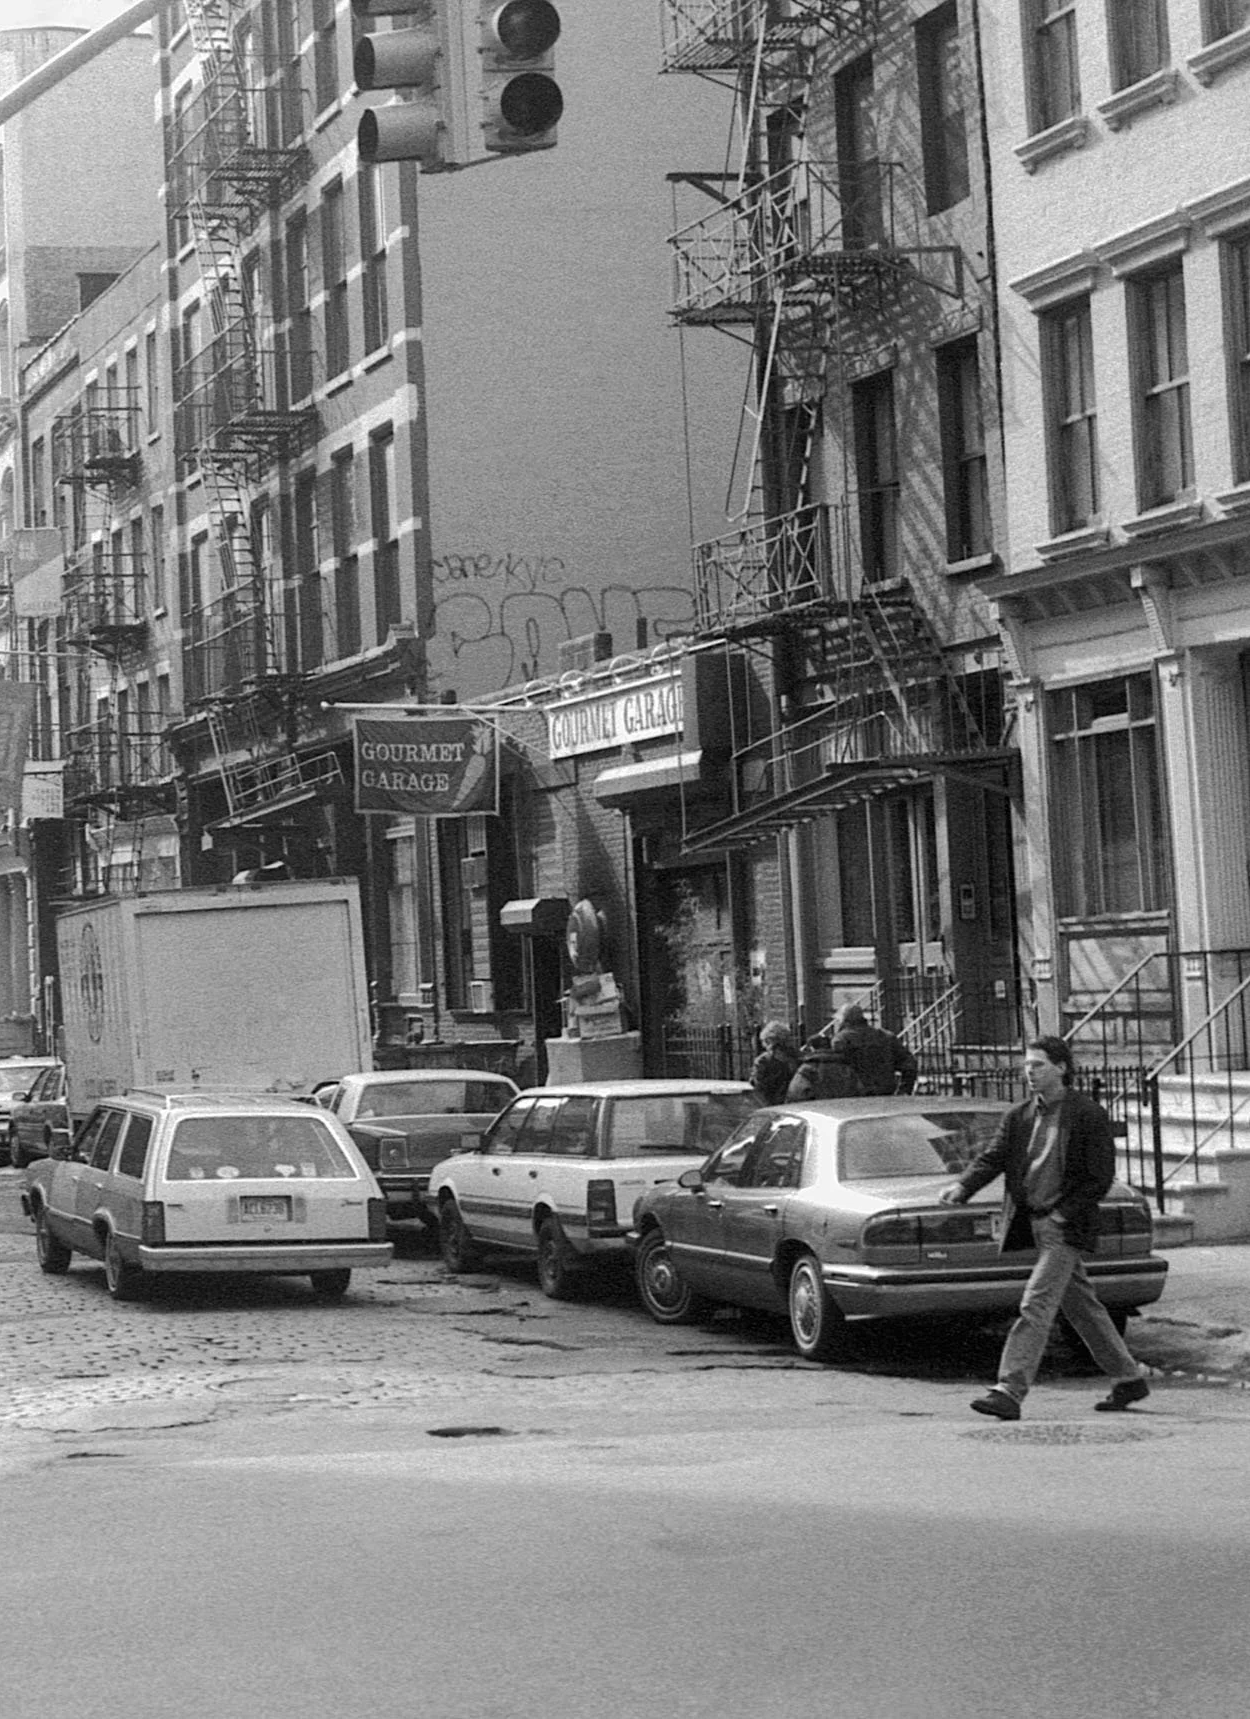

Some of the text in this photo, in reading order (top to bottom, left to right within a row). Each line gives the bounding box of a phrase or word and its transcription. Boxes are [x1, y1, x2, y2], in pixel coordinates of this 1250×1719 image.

[552, 682, 683, 750] GOURMET GARAGE
[361, 741, 466, 762] GOURMET
[361, 769, 450, 792] GARAGE
